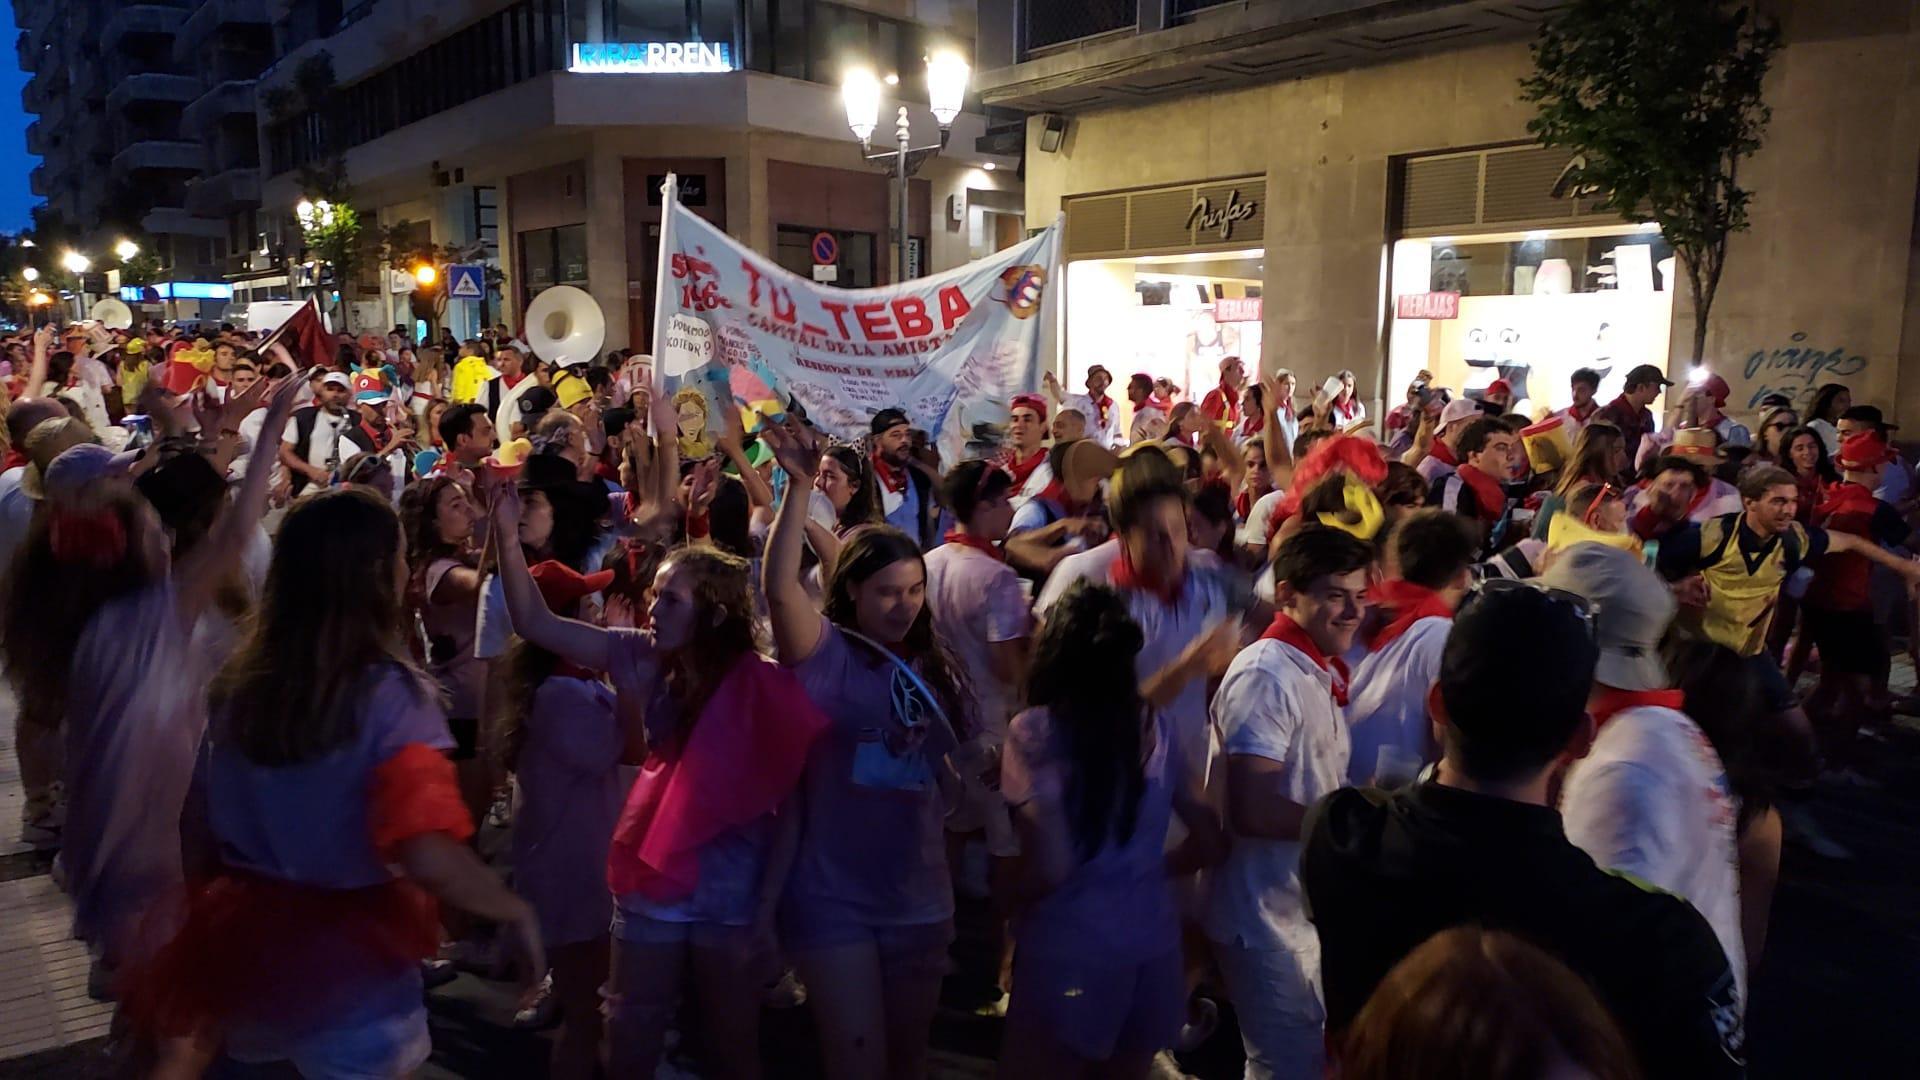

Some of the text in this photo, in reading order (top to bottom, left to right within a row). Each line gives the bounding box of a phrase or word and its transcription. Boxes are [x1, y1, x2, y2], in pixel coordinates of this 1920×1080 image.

[1401, 295, 1456, 319] REBAJAS
[825, 340, 848, 354] DE
[851, 343, 875, 357] LA
